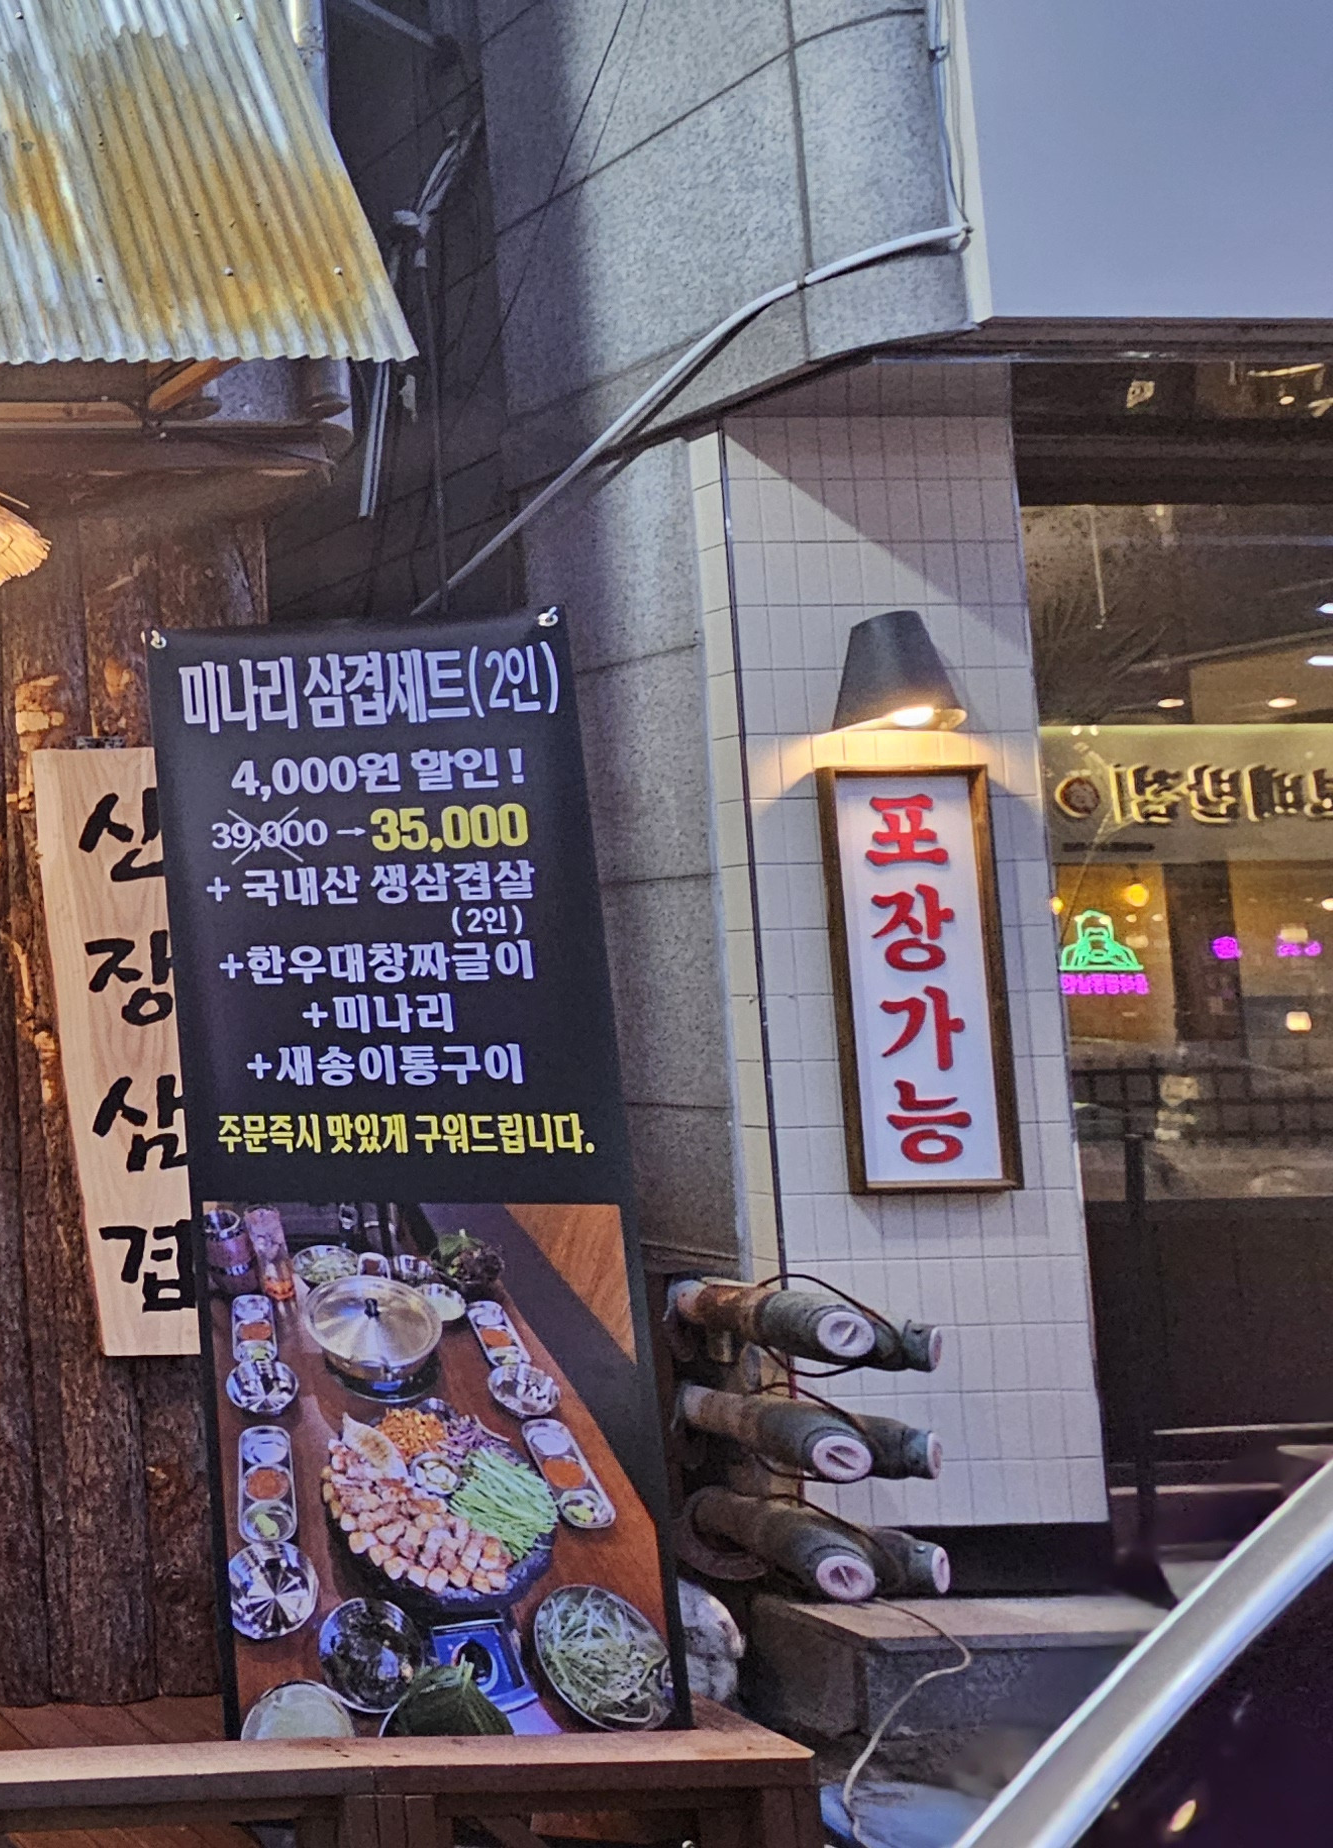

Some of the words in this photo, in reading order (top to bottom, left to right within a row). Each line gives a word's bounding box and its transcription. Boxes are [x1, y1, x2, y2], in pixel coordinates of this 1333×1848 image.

[178, 656, 299, 733] 미나리
[231, 751, 401, 801] 4,000원
[211, 817, 328, 852] 39,000
[370, 803, 529, 852] 35,000
[242, 866, 360, 906] 국내산
[370, 860, 535, 904] 생삼겹살
[452, 905, 523, 936] (2인)
[866, 793, 972, 1164] 포장가능
[218, 1114, 321, 1153] 주문즉시
[327, 1114, 408, 1154] 맛있게
[414, 1113, 595, 1154] 구워드립니다.
